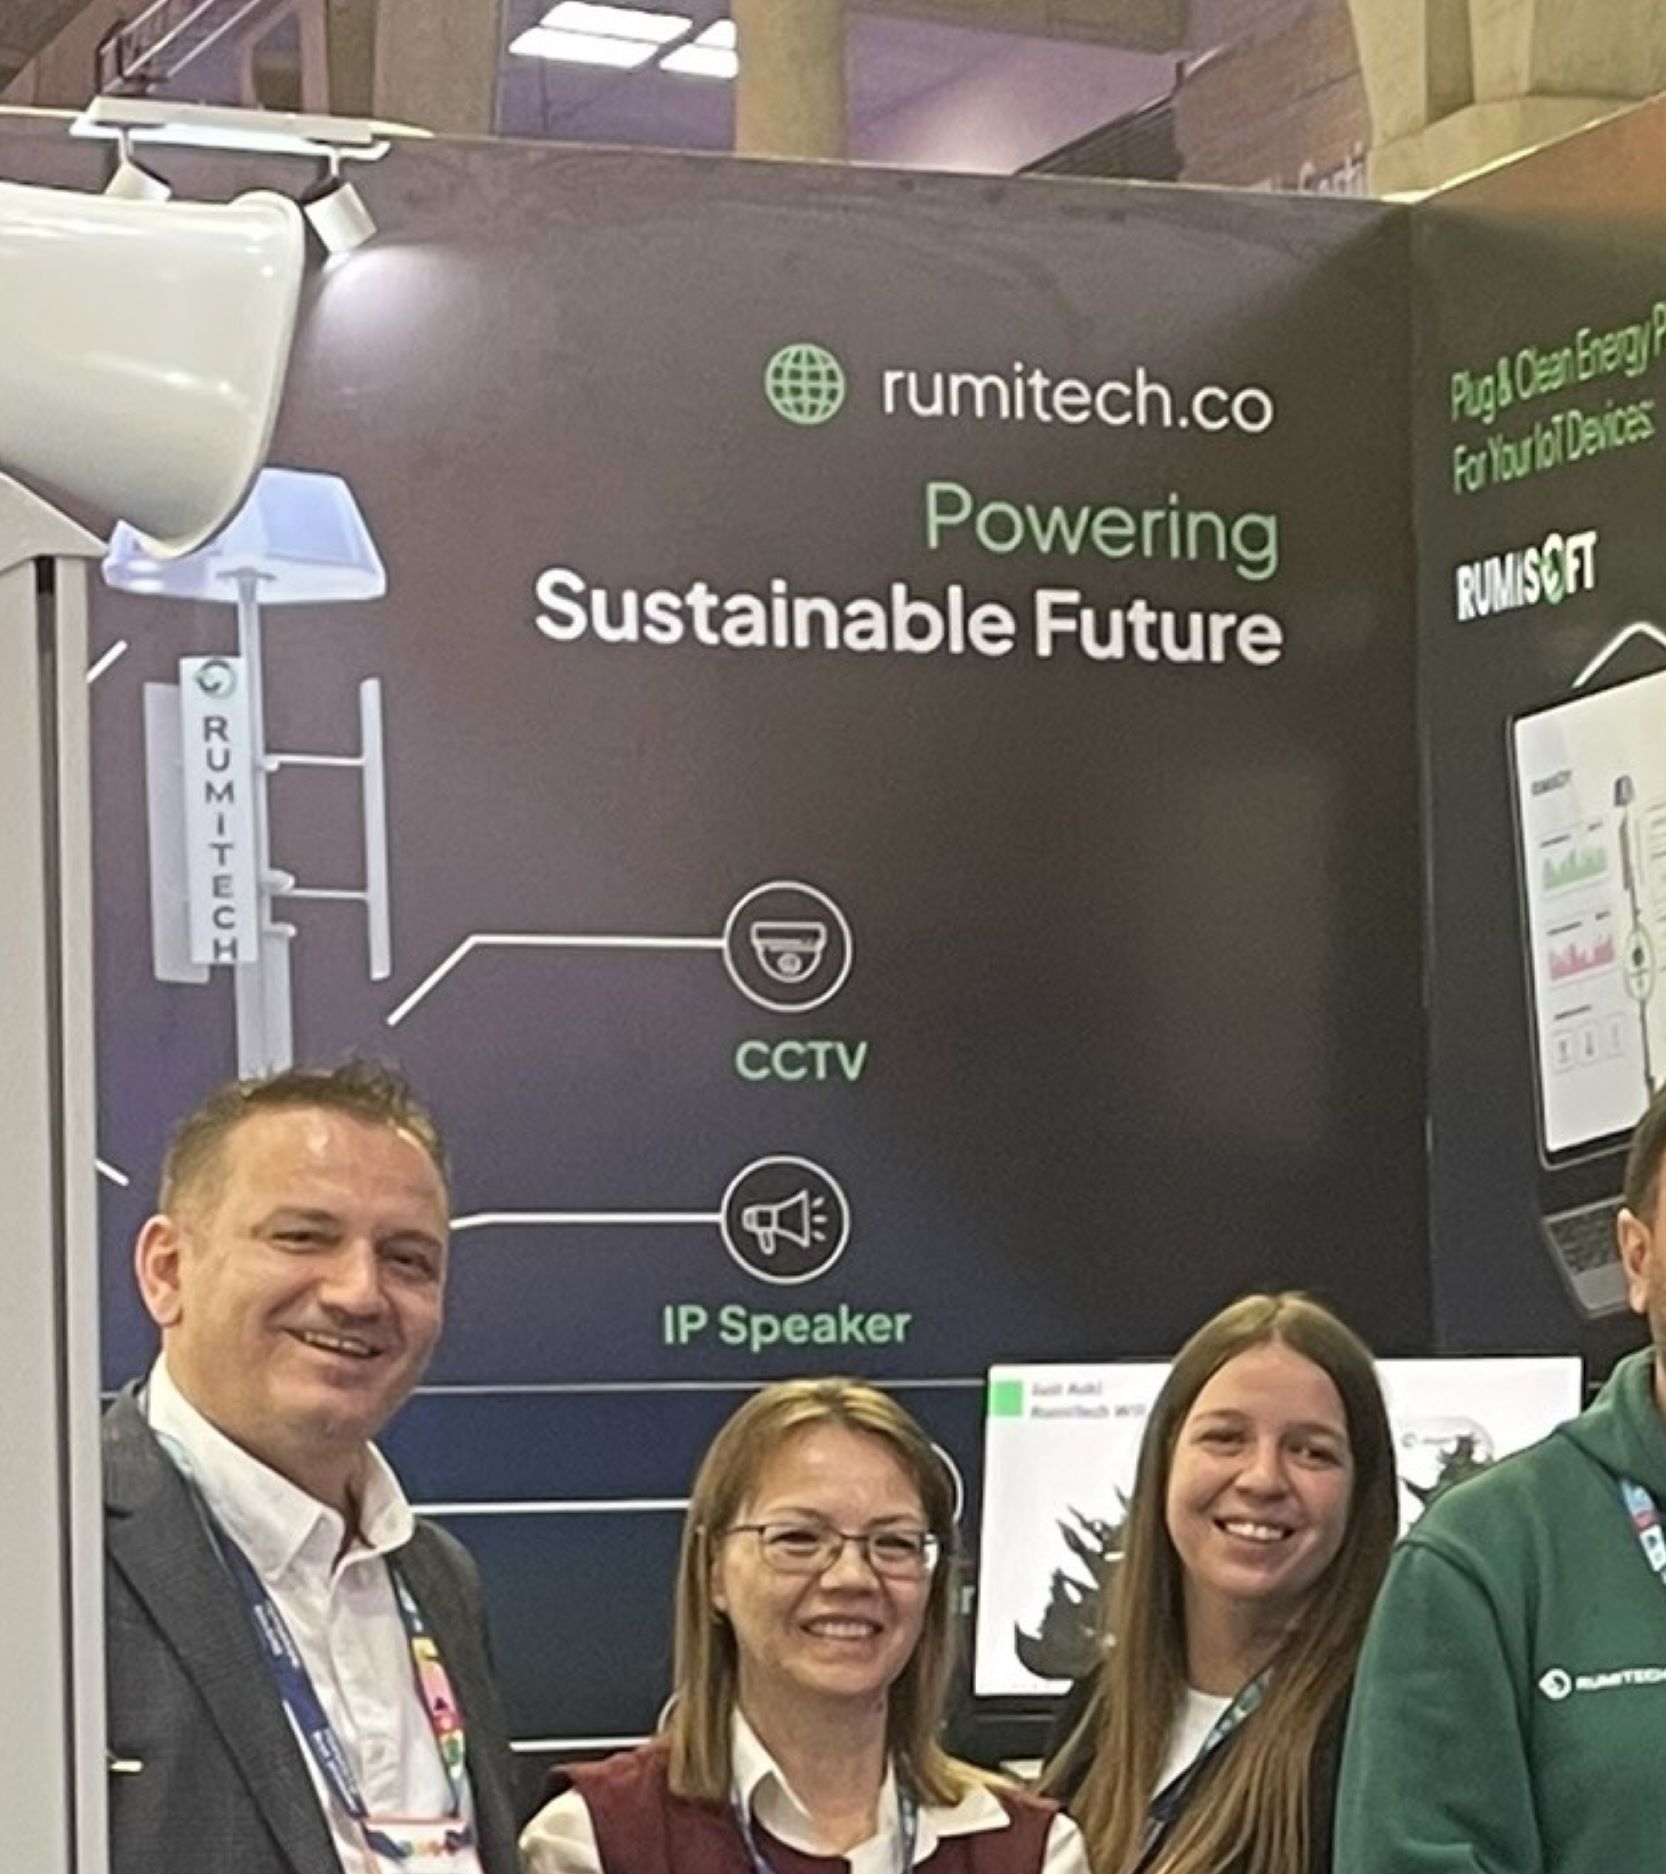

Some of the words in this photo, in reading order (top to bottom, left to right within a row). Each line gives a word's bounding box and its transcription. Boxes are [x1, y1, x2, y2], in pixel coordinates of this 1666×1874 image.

[881, 361, 1275, 434] rumitech.co
[1451, 369, 1496, 425] Plug
[1514, 345, 1577, 400] Clean
[1576, 321, 1651, 379] Energy
[1454, 445, 1488, 494] For
[1487, 432, 1534, 483] Your
[1533, 415, 1565, 472] IoT
[1565, 399, 1656, 461] Devices
[925, 481, 1279, 581] Powering
[533, 566, 1017, 656] Sustainable
[1034, 588, 1285, 667] Future
[203, 714, 238, 962] RUMITECH
[735, 1040, 868, 1082] CCTV
[663, 1304, 707, 1345] IP
[718, 1303, 912, 1352] Speaker
